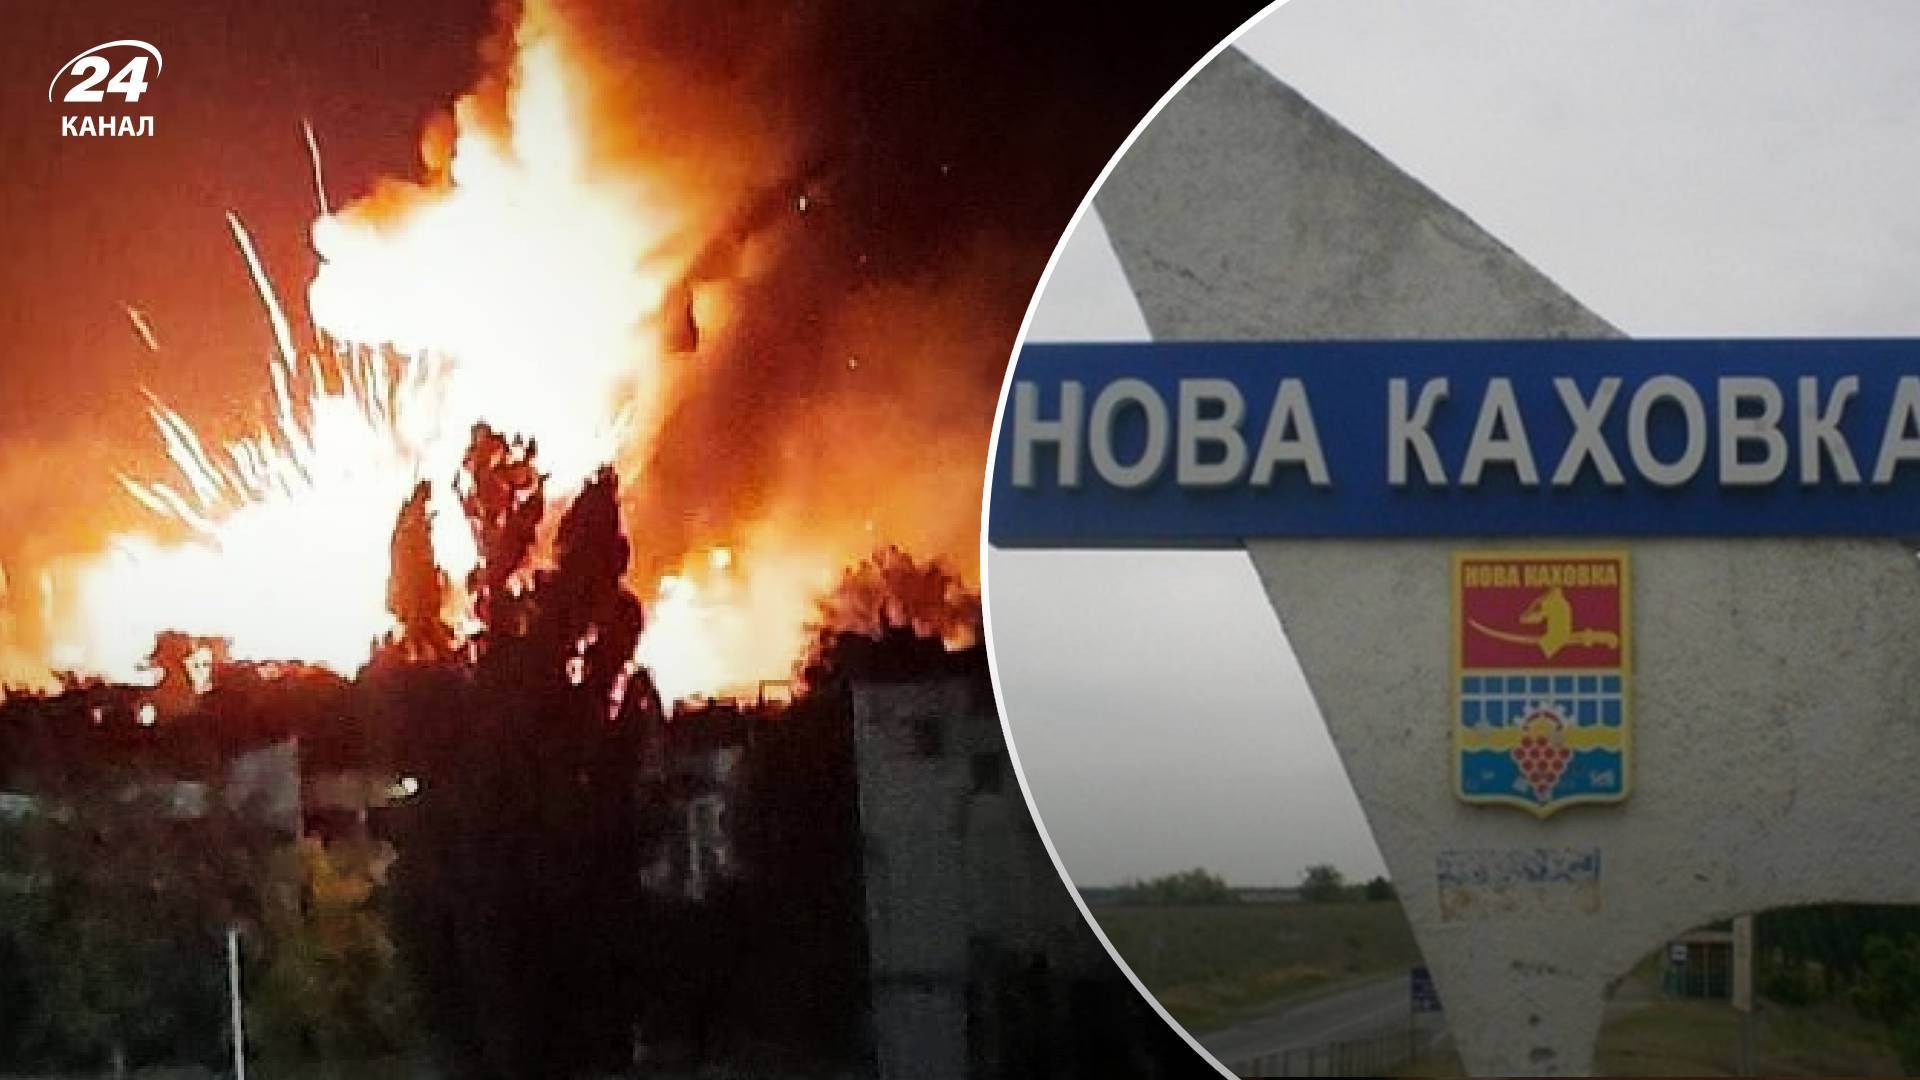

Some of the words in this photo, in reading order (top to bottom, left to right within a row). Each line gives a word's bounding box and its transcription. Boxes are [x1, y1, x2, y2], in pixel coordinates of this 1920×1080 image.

[1011, 377, 1331, 488] НОВА
[1387, 374, 1920, 487] КАХОВКА
[1464, 563, 1521, 588] НОВА
[1524, 563, 1619, 588] КАХОВКА
